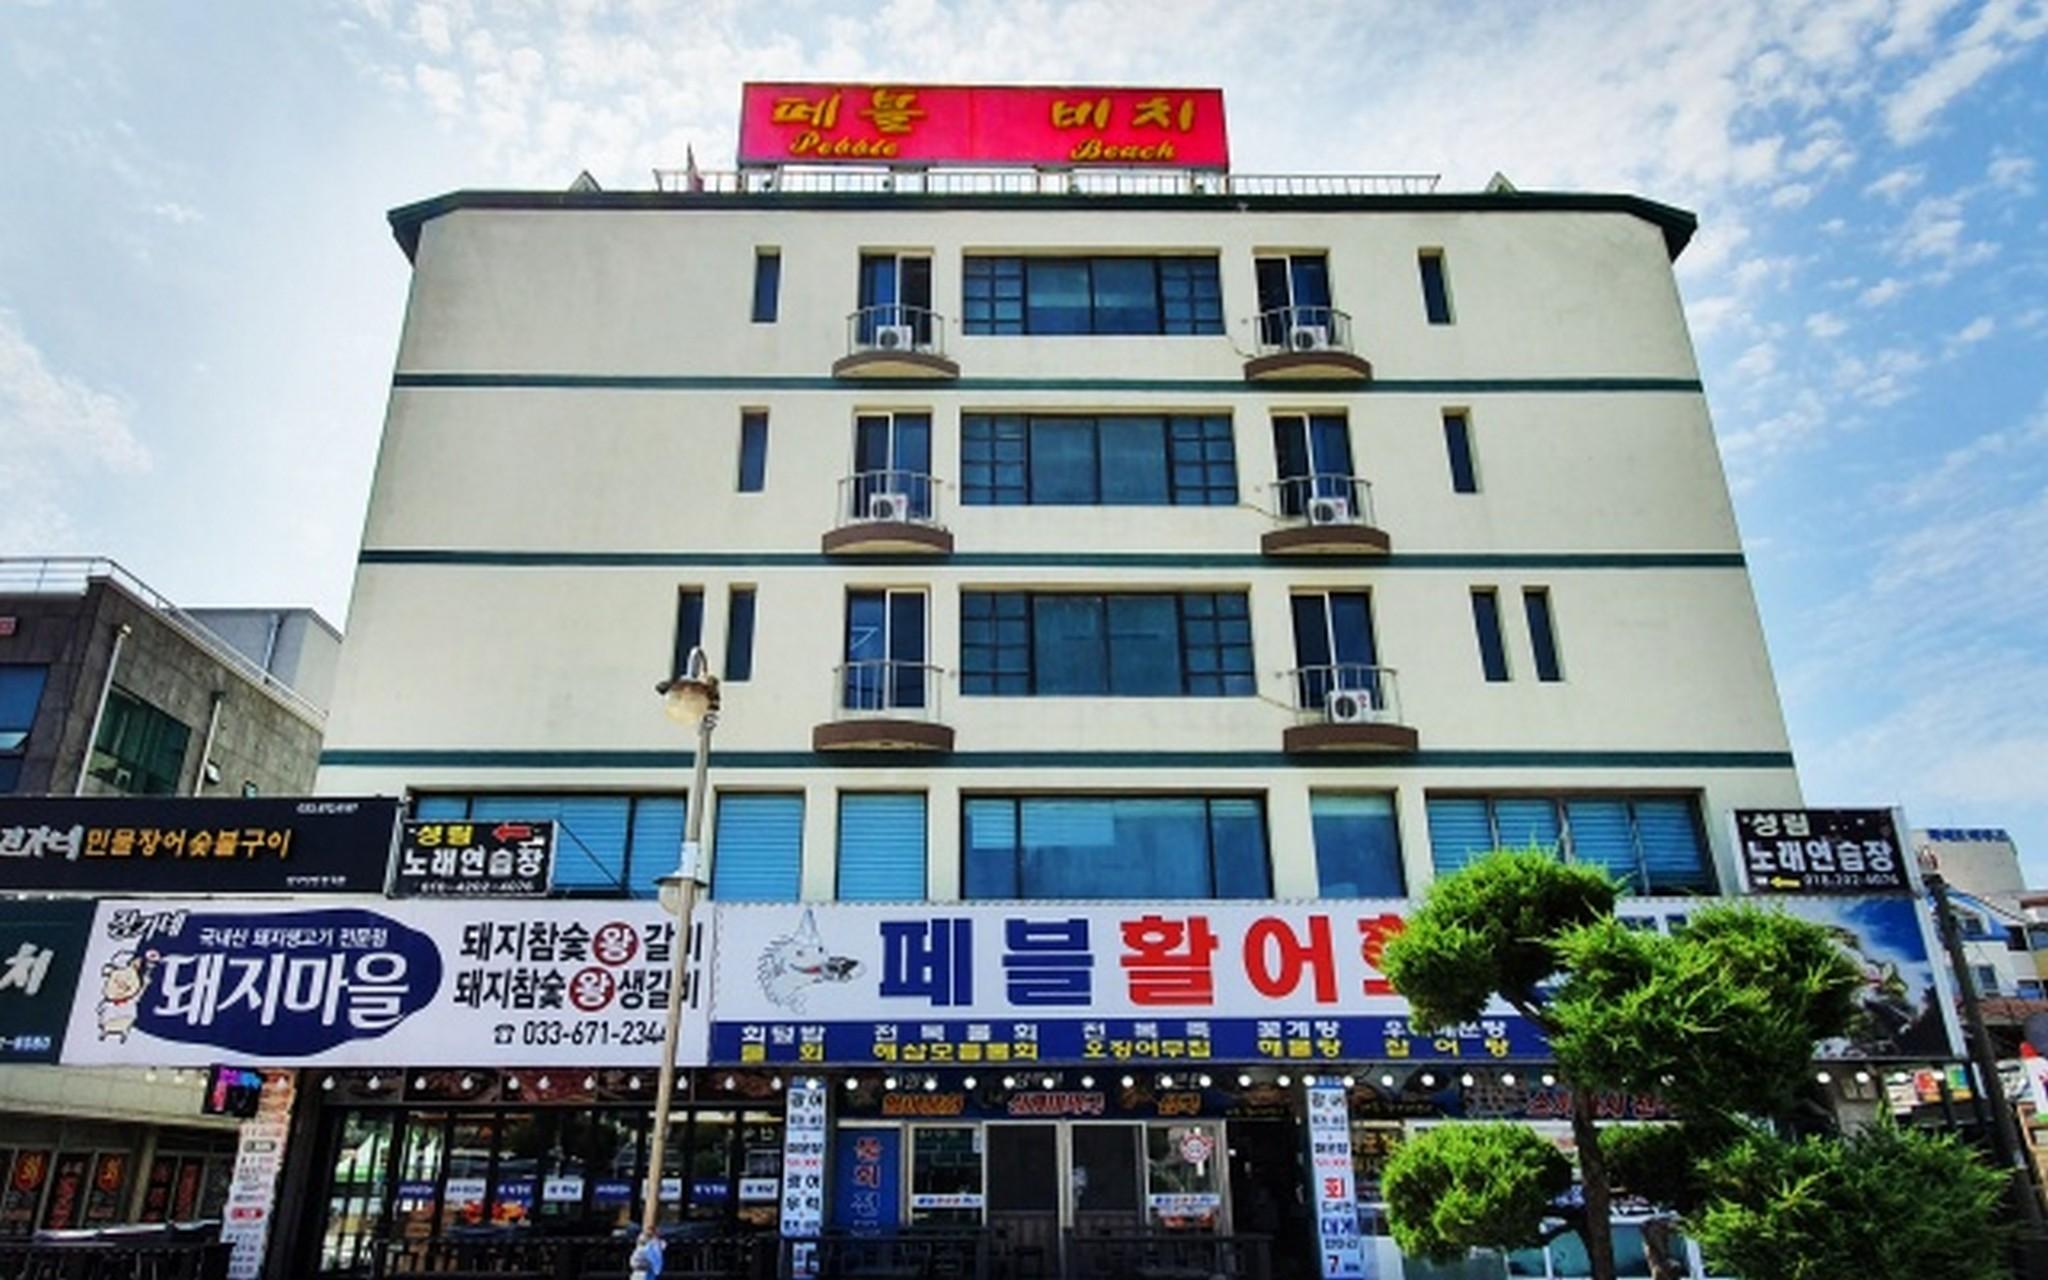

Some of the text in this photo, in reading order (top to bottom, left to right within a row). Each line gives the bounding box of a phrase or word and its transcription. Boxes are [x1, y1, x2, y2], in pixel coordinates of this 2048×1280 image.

[771, 89, 1195, 133] 페블 비치
[789, 130, 1176, 160] Pebble Beach
[402, 844, 544, 877] 노래연습장
[1747, 836, 1894, 872] 노래연습장
[200, 927, 250, 947] 국내산
[339, 927, 389, 948] 전문점
[153, 952, 411, 1030] 돼지마을
[1257, 1021, 1341, 1039] 꽃게탕
[1082, 1039, 1211, 1060] 오징어무침
[1385, 1037, 1509, 1058] 잡어탕
